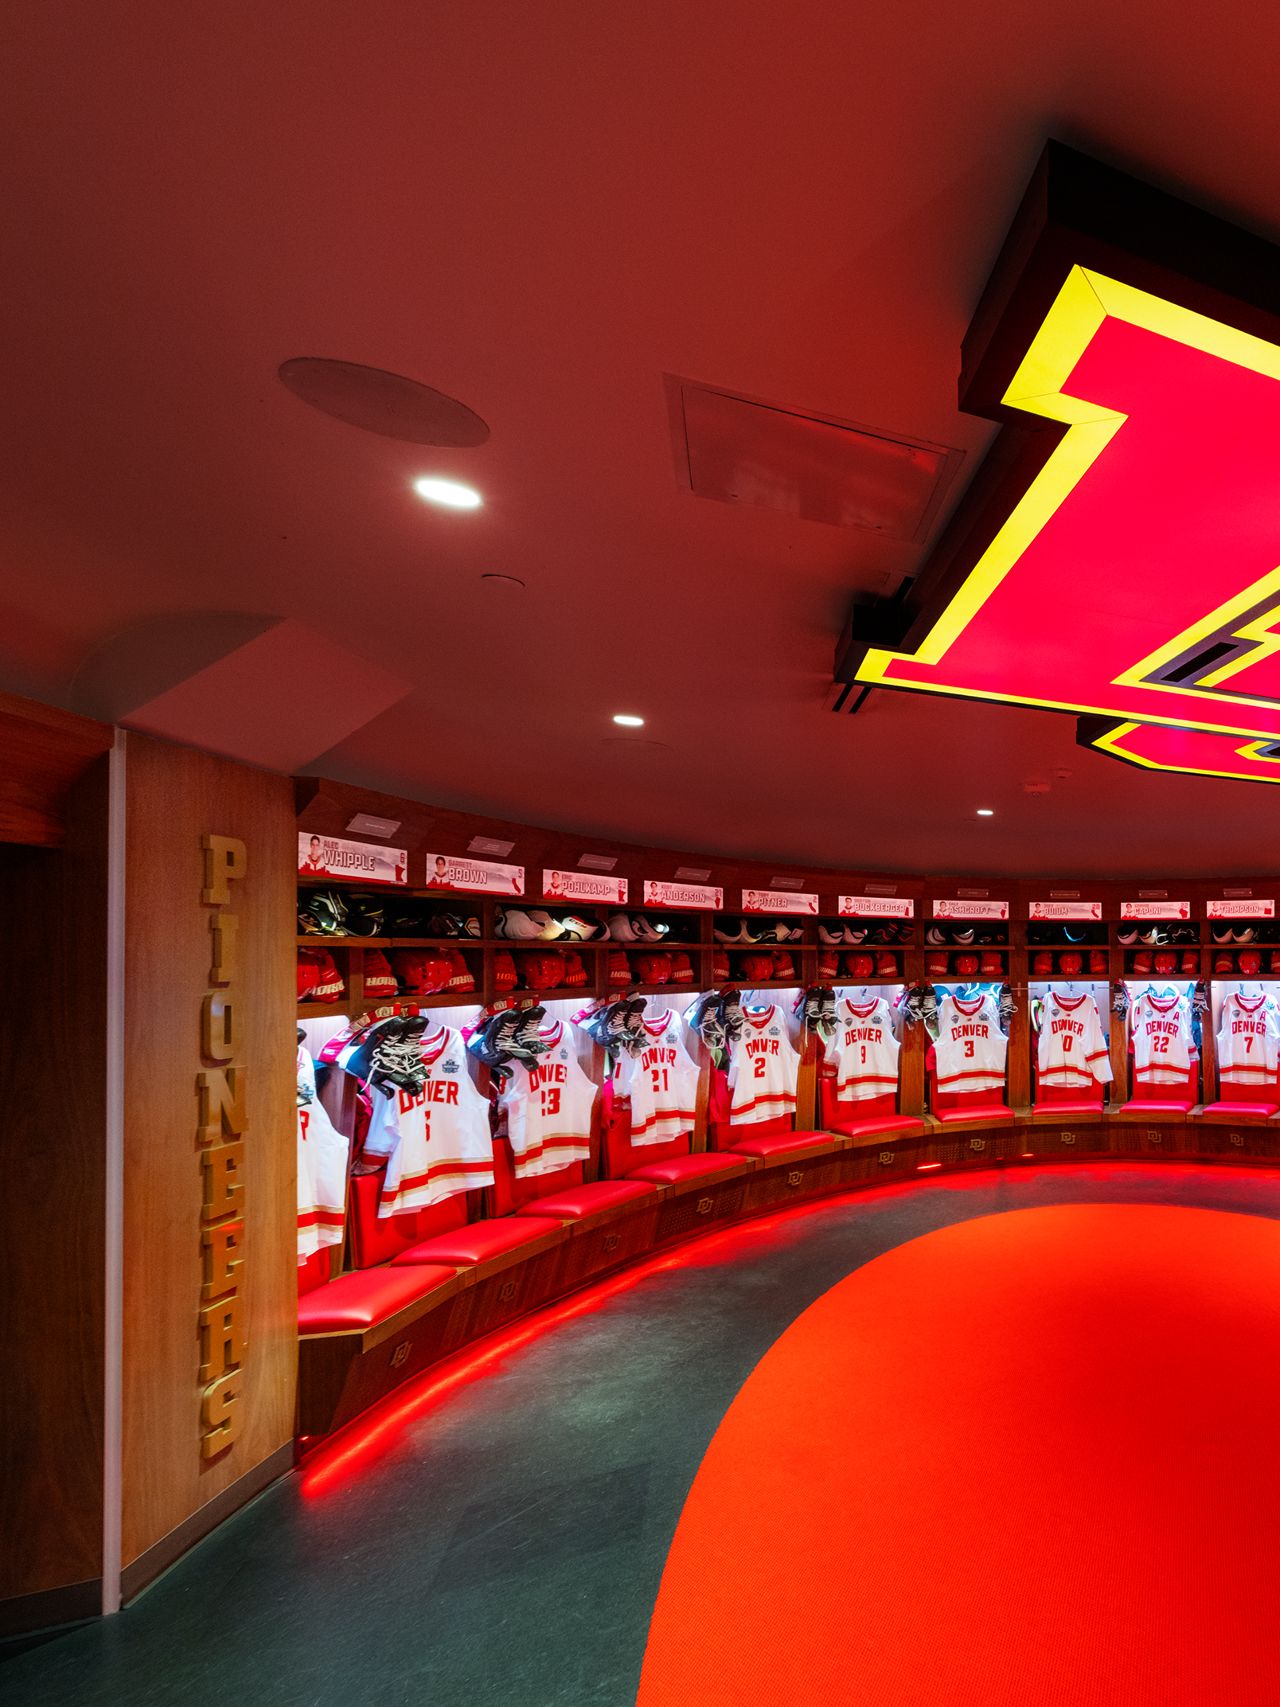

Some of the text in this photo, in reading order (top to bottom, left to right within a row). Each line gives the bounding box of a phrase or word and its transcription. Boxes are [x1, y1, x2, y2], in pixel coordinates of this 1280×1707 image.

[323, 850, 376, 872] WHIPPLE
[449, 867, 488, 884] BROWN
[561, 880, 612, 895] POHLKAMP
[660, 890, 706, 904] ANDERSON
[758, 898, 789, 908] PITNER
[853, 903, 905, 913] BUCKBERGER
[949, 905, 991, 915] ASHCROFT
[1219, 904, 1260, 914] THOMPSON
[1172, 1012, 1180, 1021] A
[1259, 1010, 1266, 1022] A
[951, 1024, 989, 1041] DENVER
[1146, 1022, 1179, 1037] DENVER
[1231, 1021, 1267, 1035] DENVER
[844, 1028, 883, 1047] DENVER
[1153, 1036, 1170, 1053] 22
[1244, 1036, 1253, 1053] 7
[745, 1038, 780, 1059] DNVR
[964, 1041, 975, 1058] 3
[642, 1047, 677, 1072] DNVR
[754, 1057, 766, 1078] 2
[529, 1064, 568, 1093] DNVE
[199, 834, 248, 1460] PIONEERS
